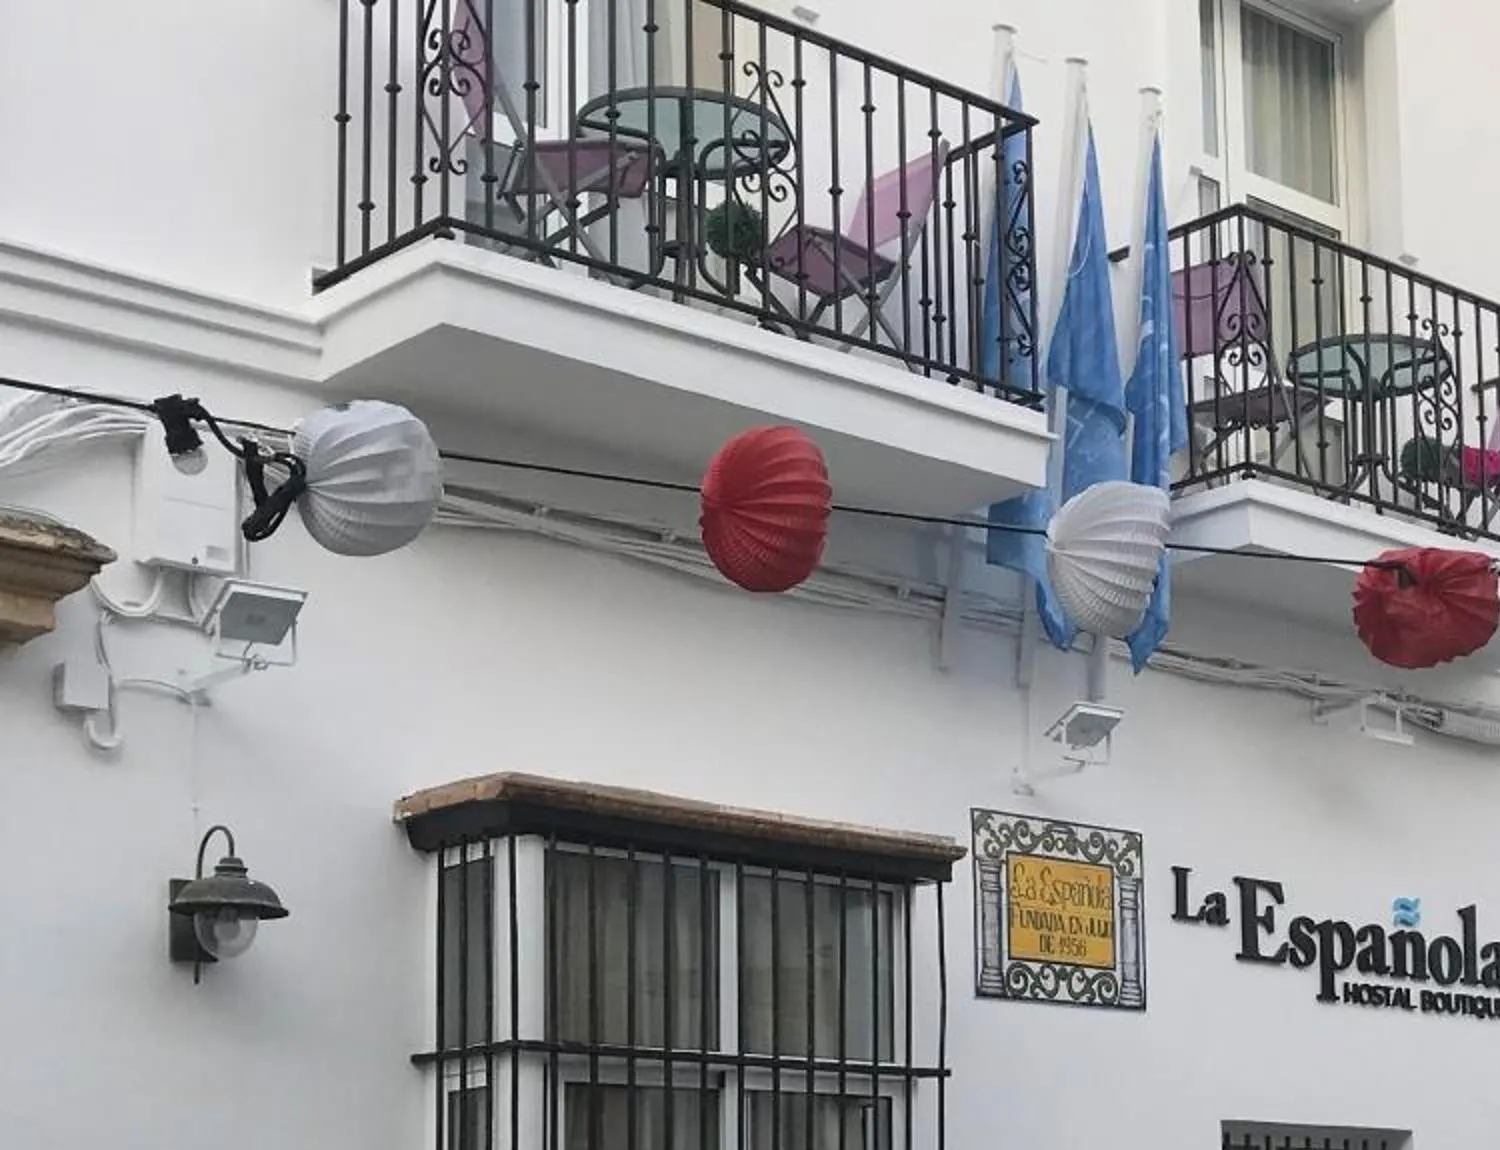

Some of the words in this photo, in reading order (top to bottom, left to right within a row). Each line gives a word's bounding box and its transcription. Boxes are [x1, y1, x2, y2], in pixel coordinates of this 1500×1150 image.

[1013, 862, 1036, 900] La
[1171, 866, 1230, 926] La
[1343, 982, 1417, 1011] HOSTAL
